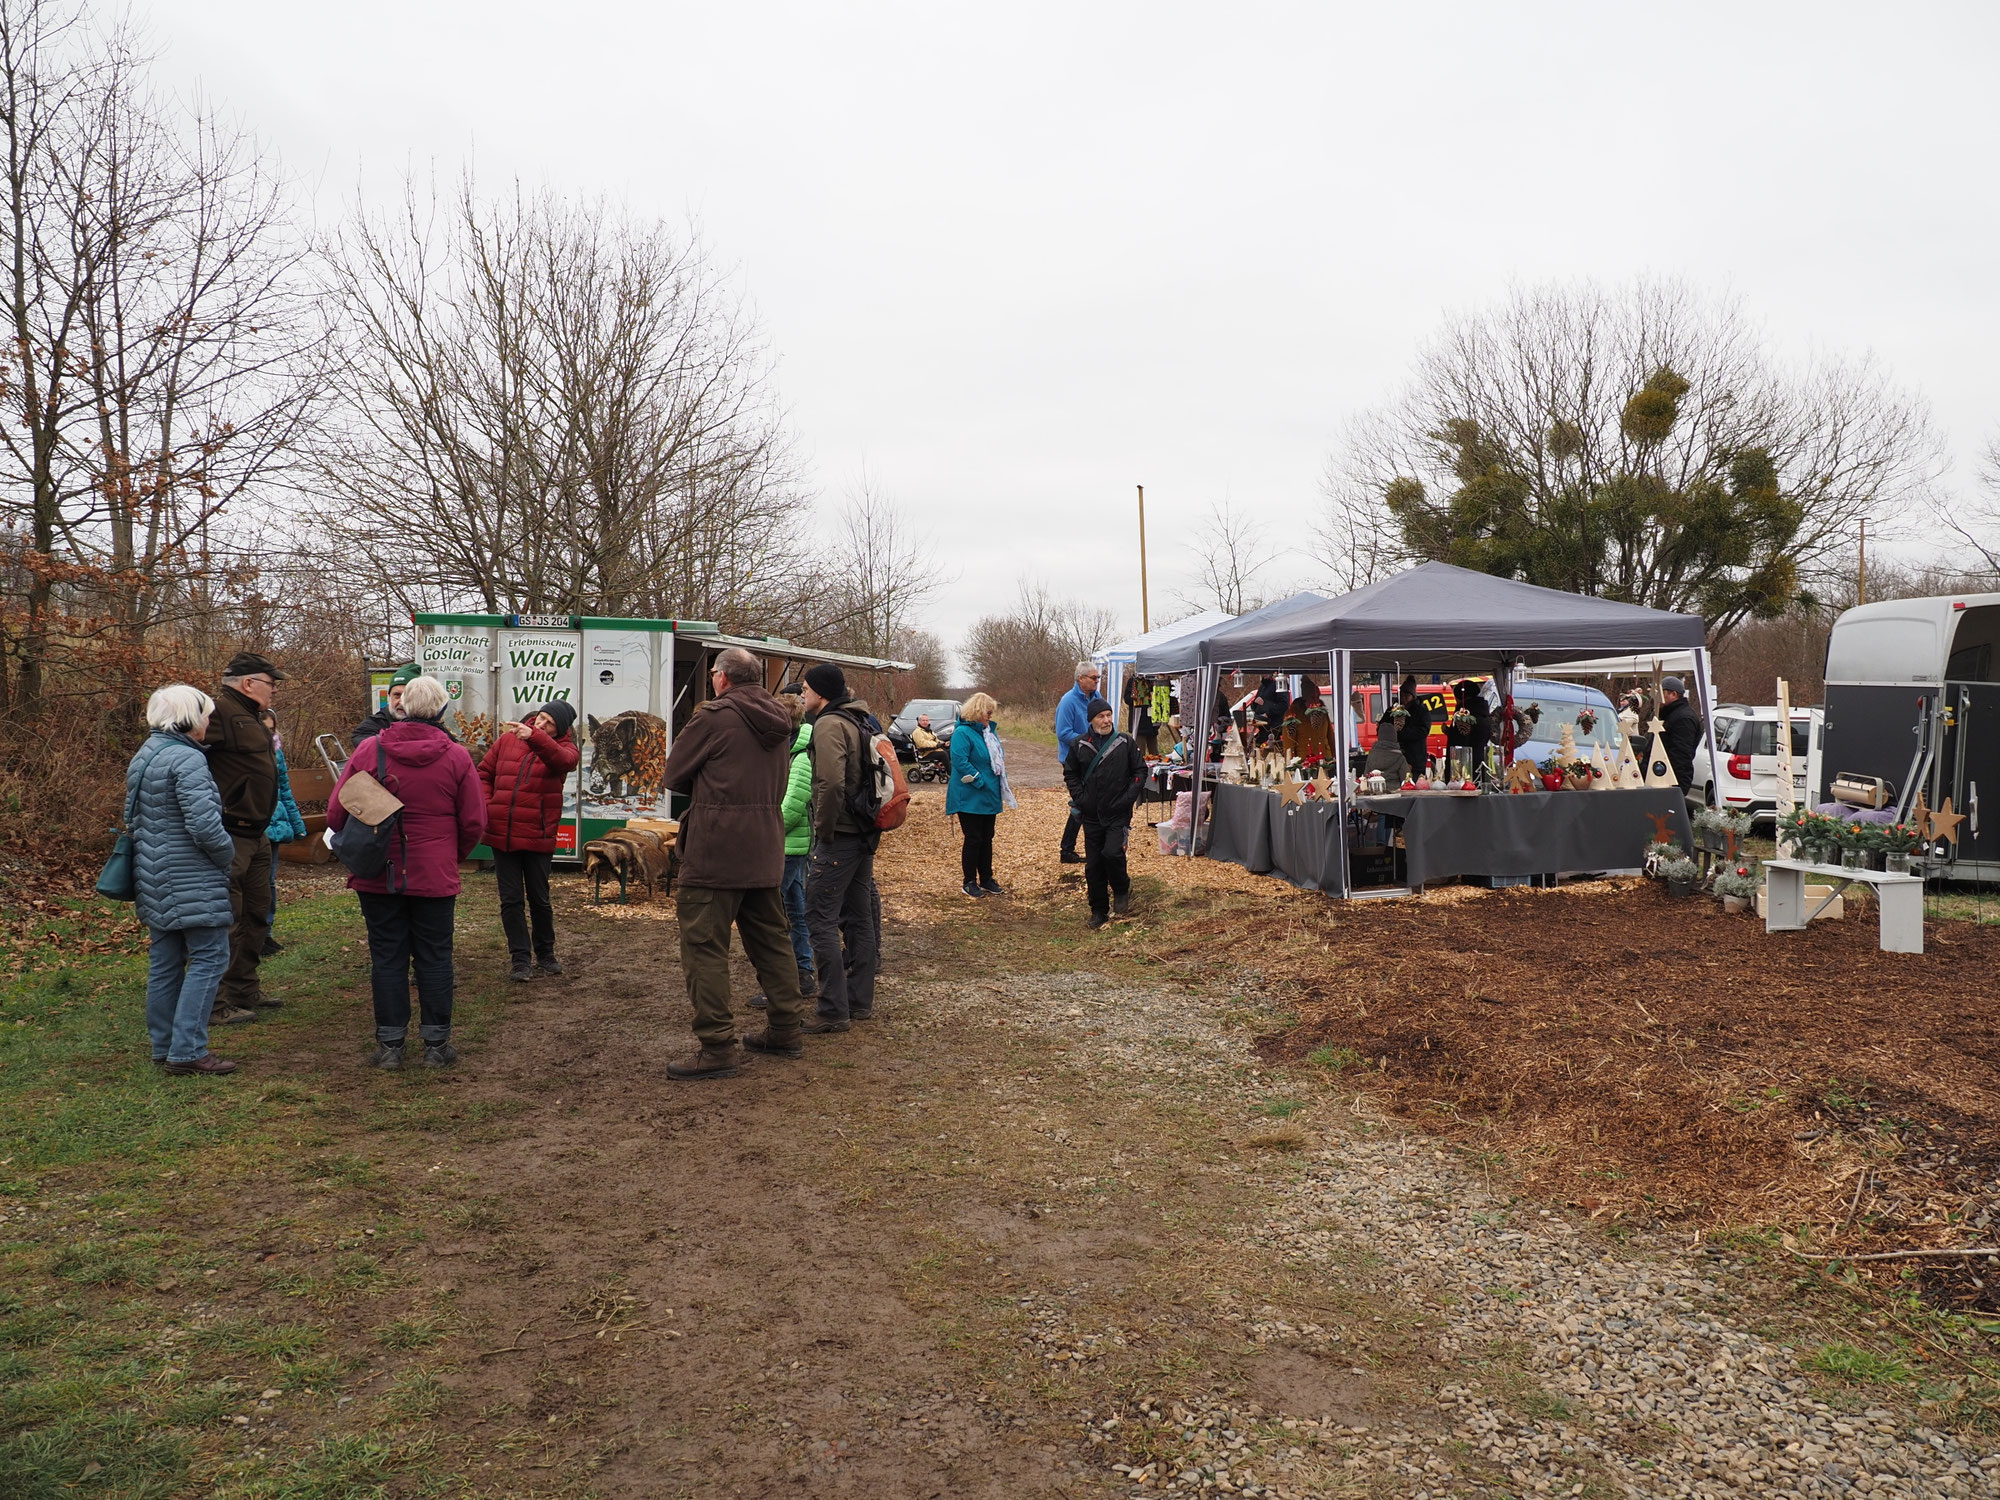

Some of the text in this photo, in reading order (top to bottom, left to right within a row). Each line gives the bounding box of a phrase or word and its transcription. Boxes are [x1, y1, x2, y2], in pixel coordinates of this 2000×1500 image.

[519, 616, 569, 627] GS JS 204
[422, 634, 490, 648] Jägerschaft
[508, 638, 577, 649] Erlebnisschule
[423, 647, 486, 664] Goslar e.V.
[509, 649, 575, 669] Wald
[423, 665, 485, 675] www.LJN.de/goslar
[526, 670, 558, 682] und
[512, 684, 571, 704] Wild
[1422, 695, 1444, 712] 12
